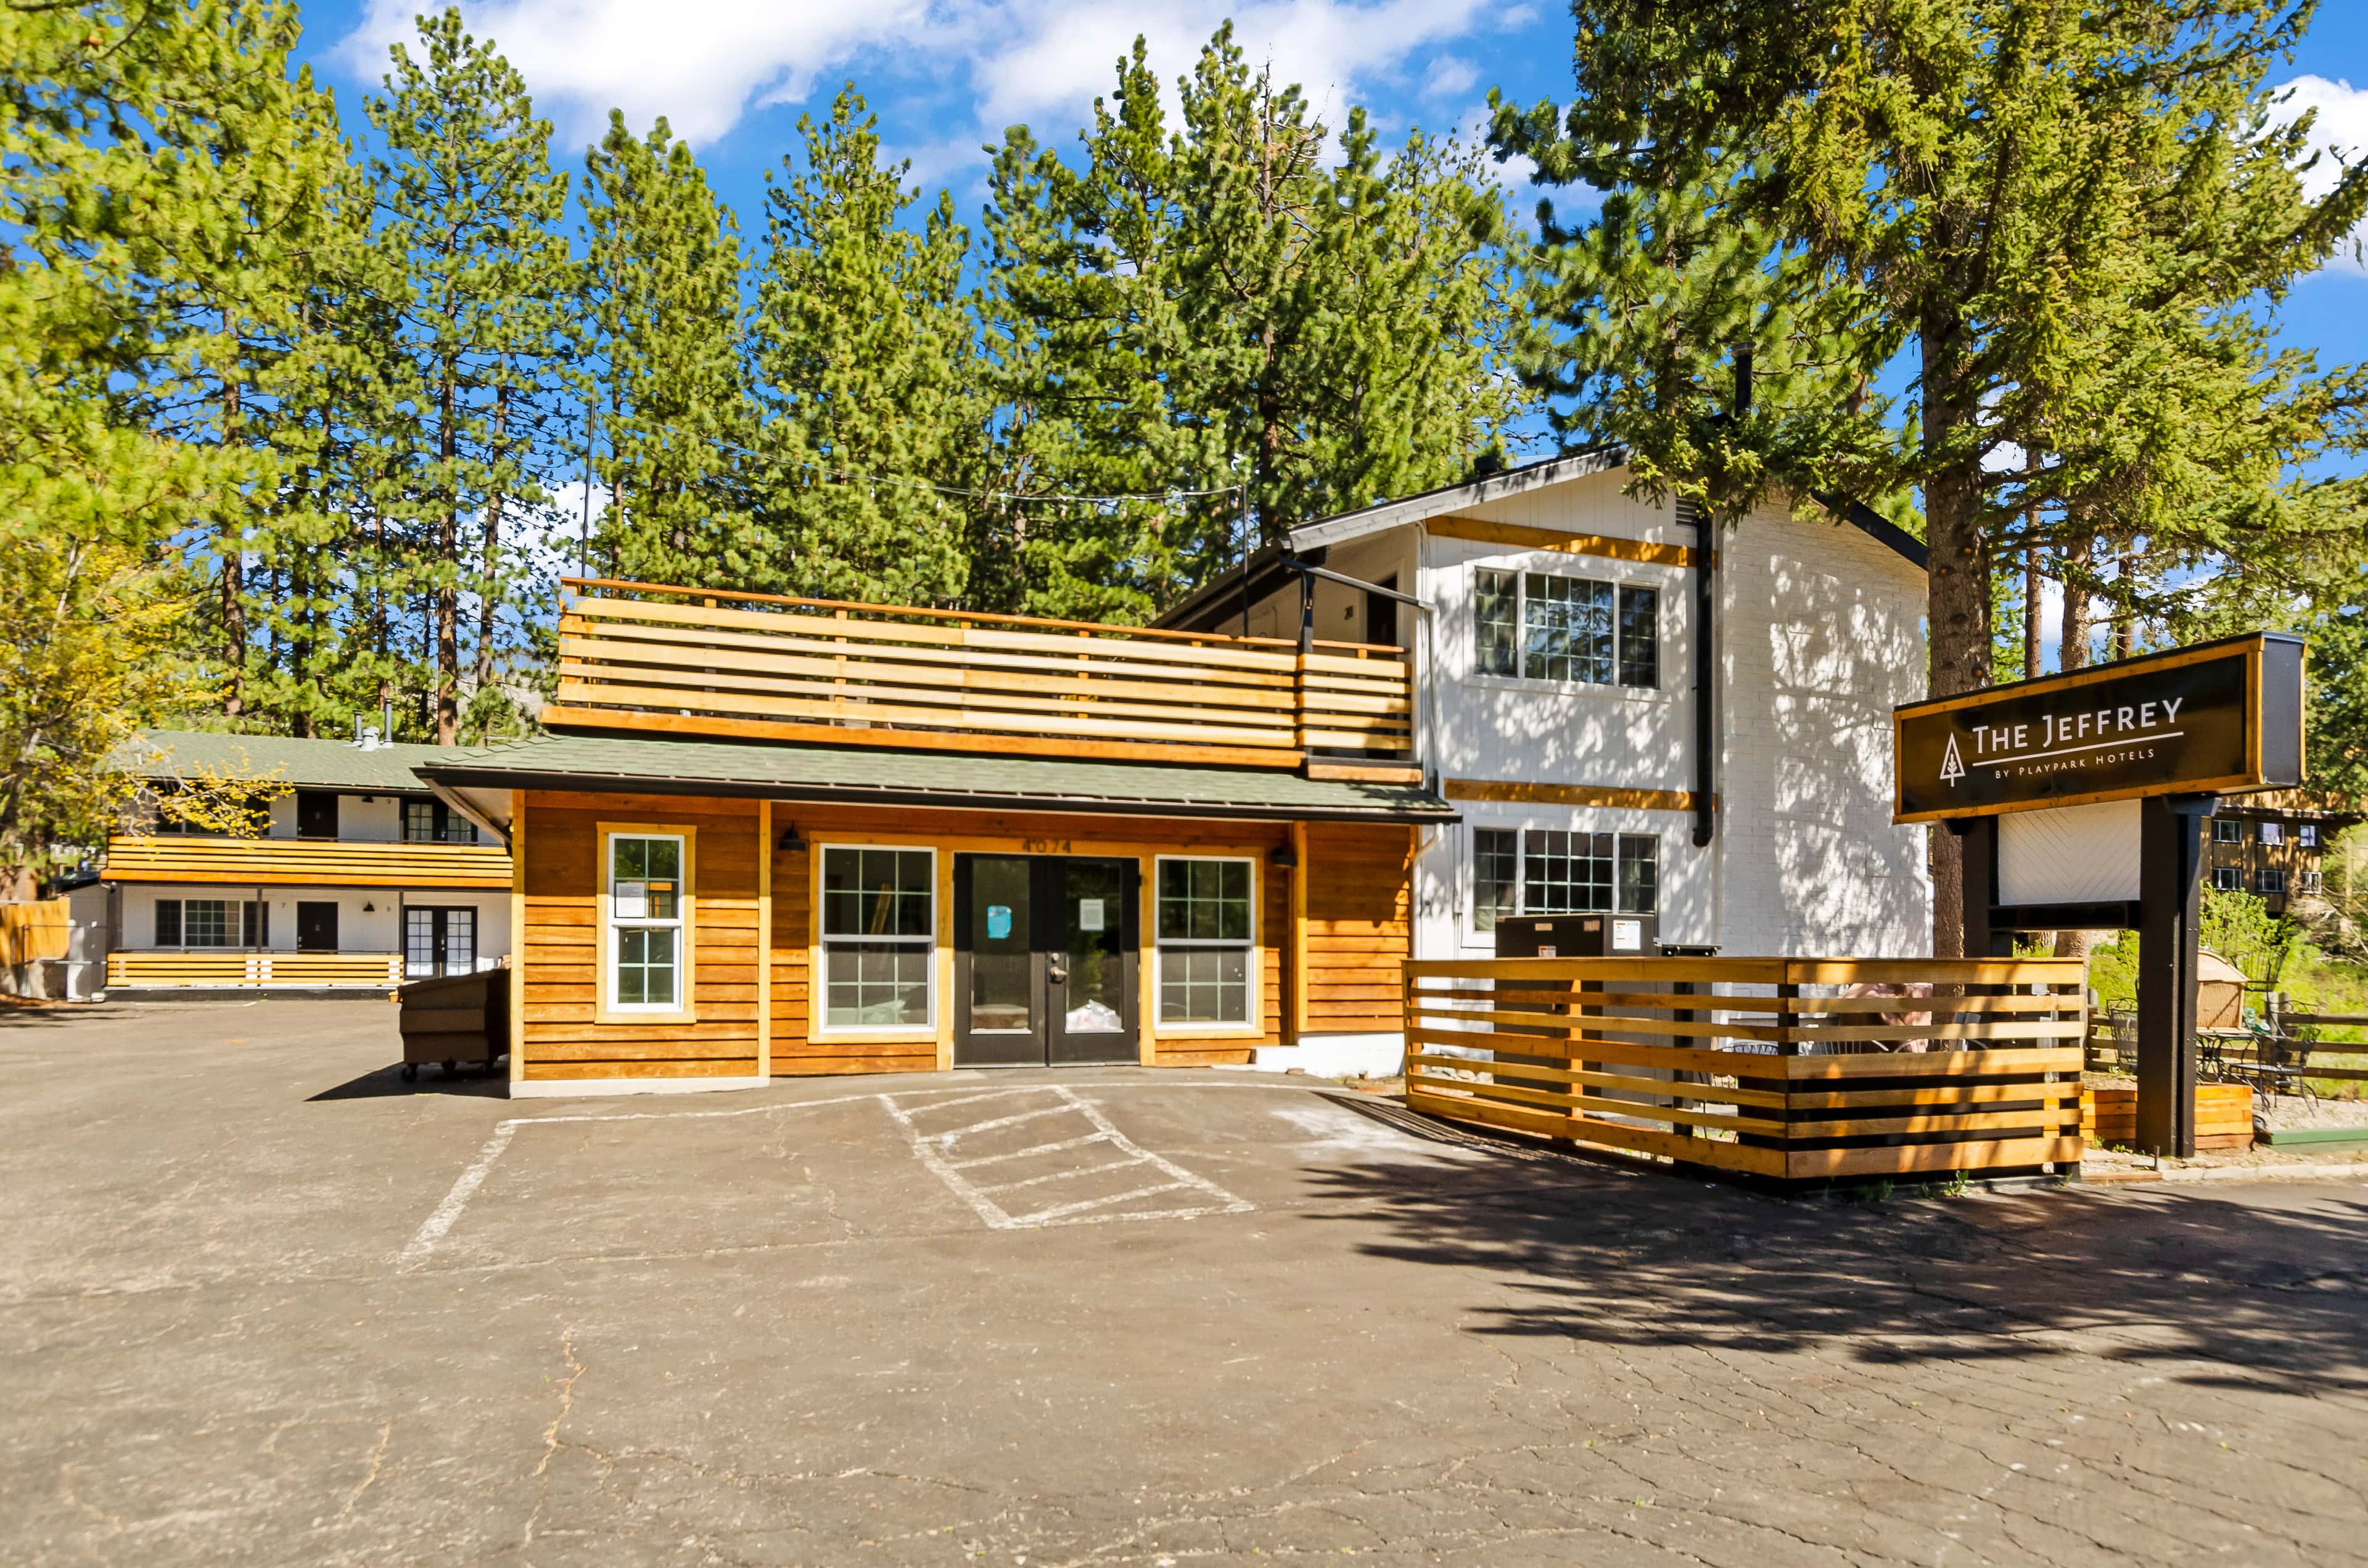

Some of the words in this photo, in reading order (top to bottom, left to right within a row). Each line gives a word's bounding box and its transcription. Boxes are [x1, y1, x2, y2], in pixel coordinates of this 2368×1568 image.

[1973, 726, 2028, 753] THE
[2042, 697, 2183, 748] JEFFREY
[1996, 770, 2009, 779] BY
[2019, 758, 2086, 775] PLAYPARK
[2096, 749, 2155, 765] HOTELS
[1021, 839, 1071, 853] 4074
